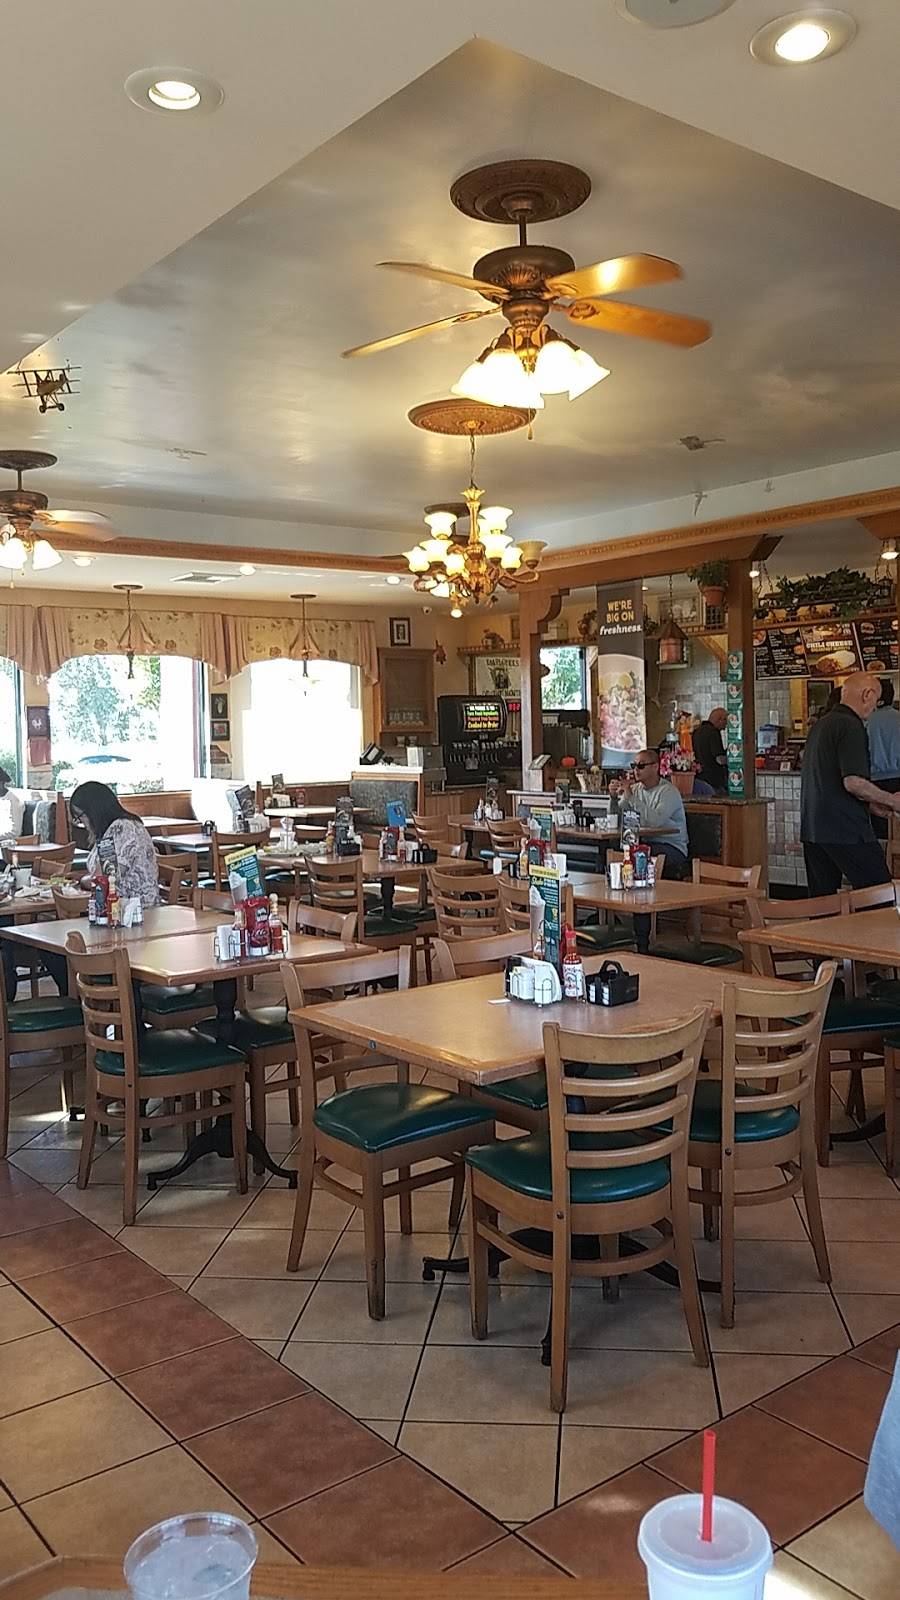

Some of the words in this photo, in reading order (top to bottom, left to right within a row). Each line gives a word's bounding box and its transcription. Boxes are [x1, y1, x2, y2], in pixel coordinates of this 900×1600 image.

[607, 599, 633, 611] WE'RE
[606, 612, 620, 623] BIG
[621, 610, 635, 622] ON
[599, 624, 643, 635] freshness.
